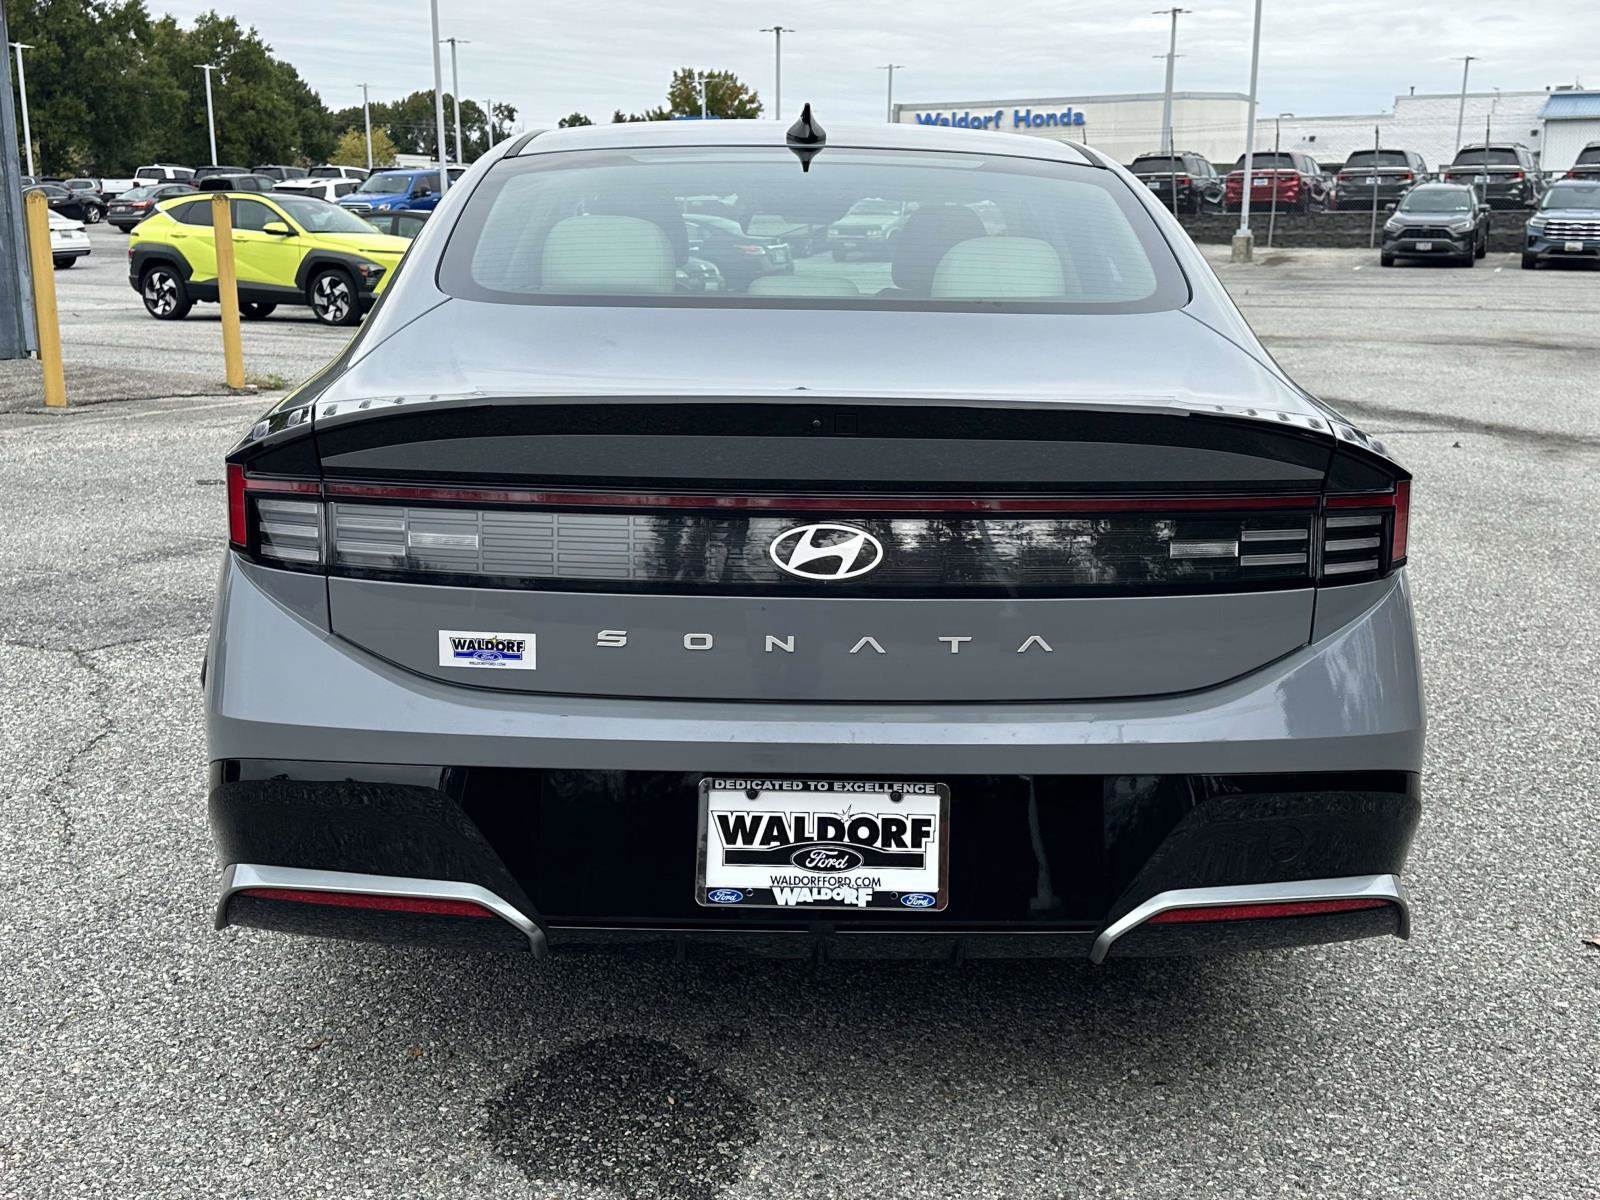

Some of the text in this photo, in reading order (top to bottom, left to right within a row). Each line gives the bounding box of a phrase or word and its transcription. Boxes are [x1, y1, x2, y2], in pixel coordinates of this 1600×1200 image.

[915, 107, 1086, 129] Waldorf Honda
[451, 638, 525, 652] WALDORF
[596, 629, 1054, 654] SONATA
[714, 780, 936, 794] DEDICATED TO EXCELLENCE
[715, 813, 933, 849] WALDORF
[805, 850, 849, 869] Ford
[770, 875, 881, 887] WALDORFFORD.COM
[713, 890, 737, 902] Ford
[771, 886, 874, 907] WALDORF
[906, 894, 929, 906] Ford
